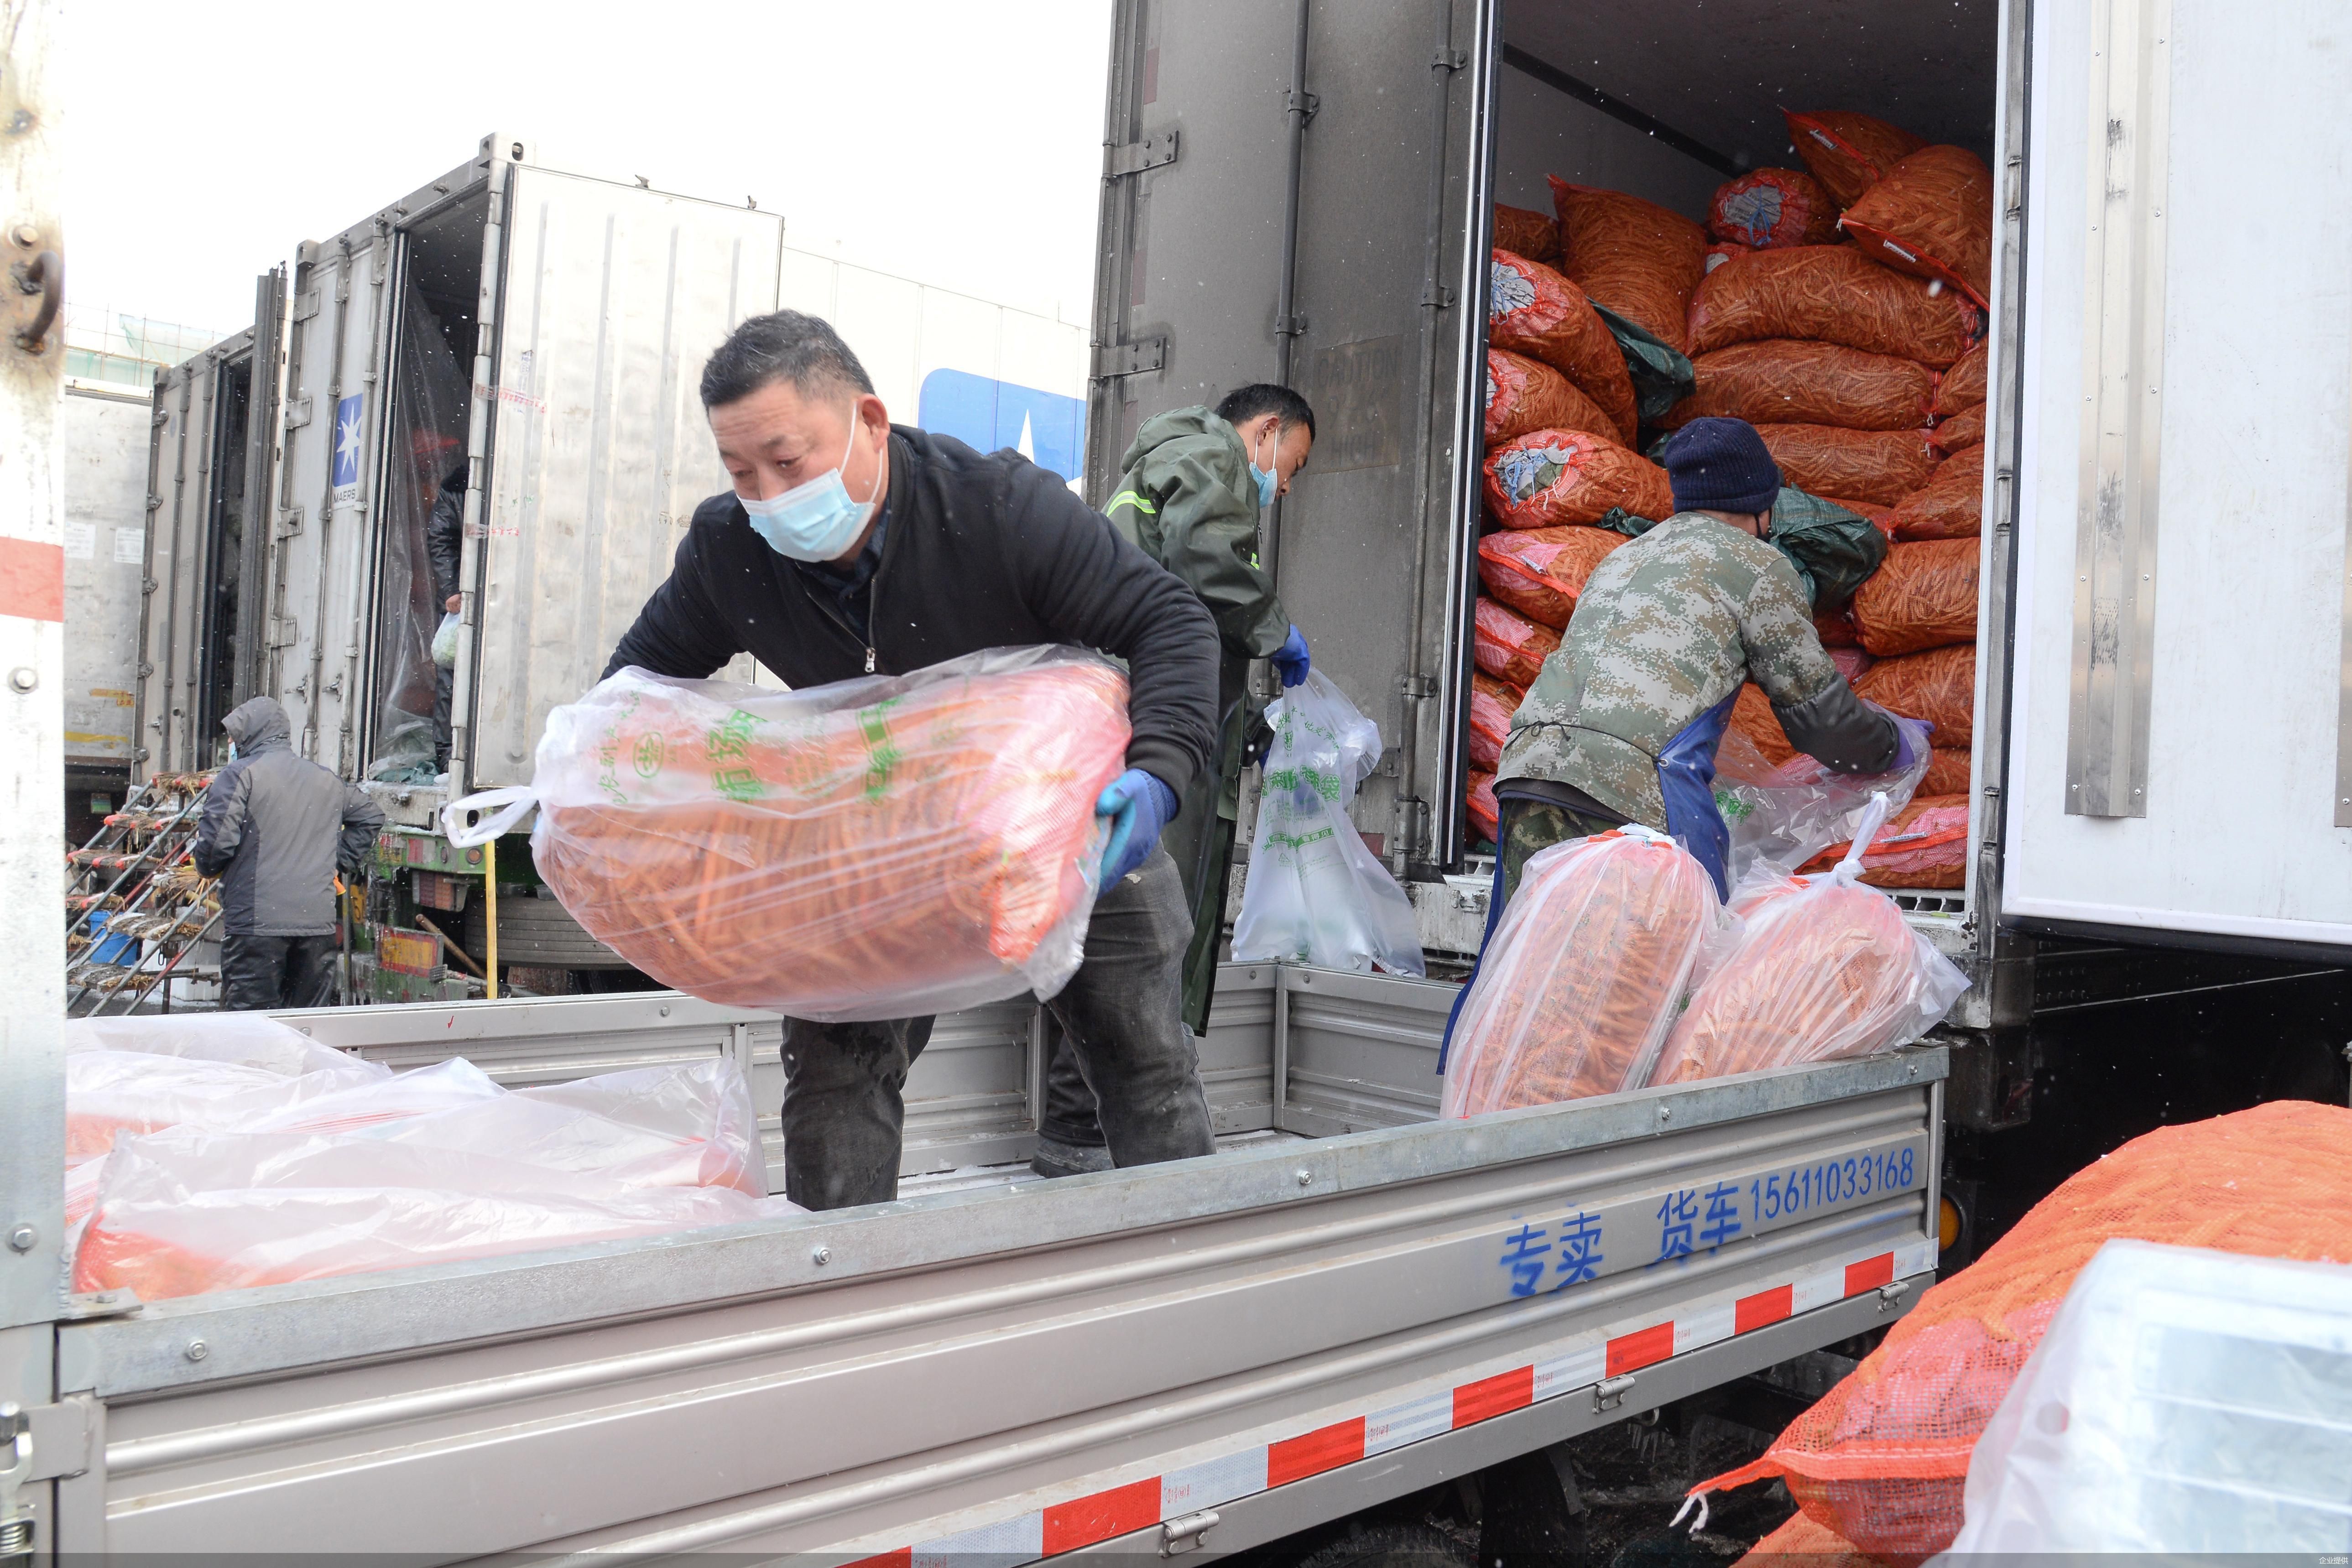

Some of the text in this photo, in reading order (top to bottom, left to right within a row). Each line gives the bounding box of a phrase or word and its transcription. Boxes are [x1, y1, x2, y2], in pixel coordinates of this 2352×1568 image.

[1318, 346, 1400, 389] CAUTION
[333, 489, 356, 504] MAERS
[1500, 1147, 1914, 1297] 专卖 货车 15611033168
